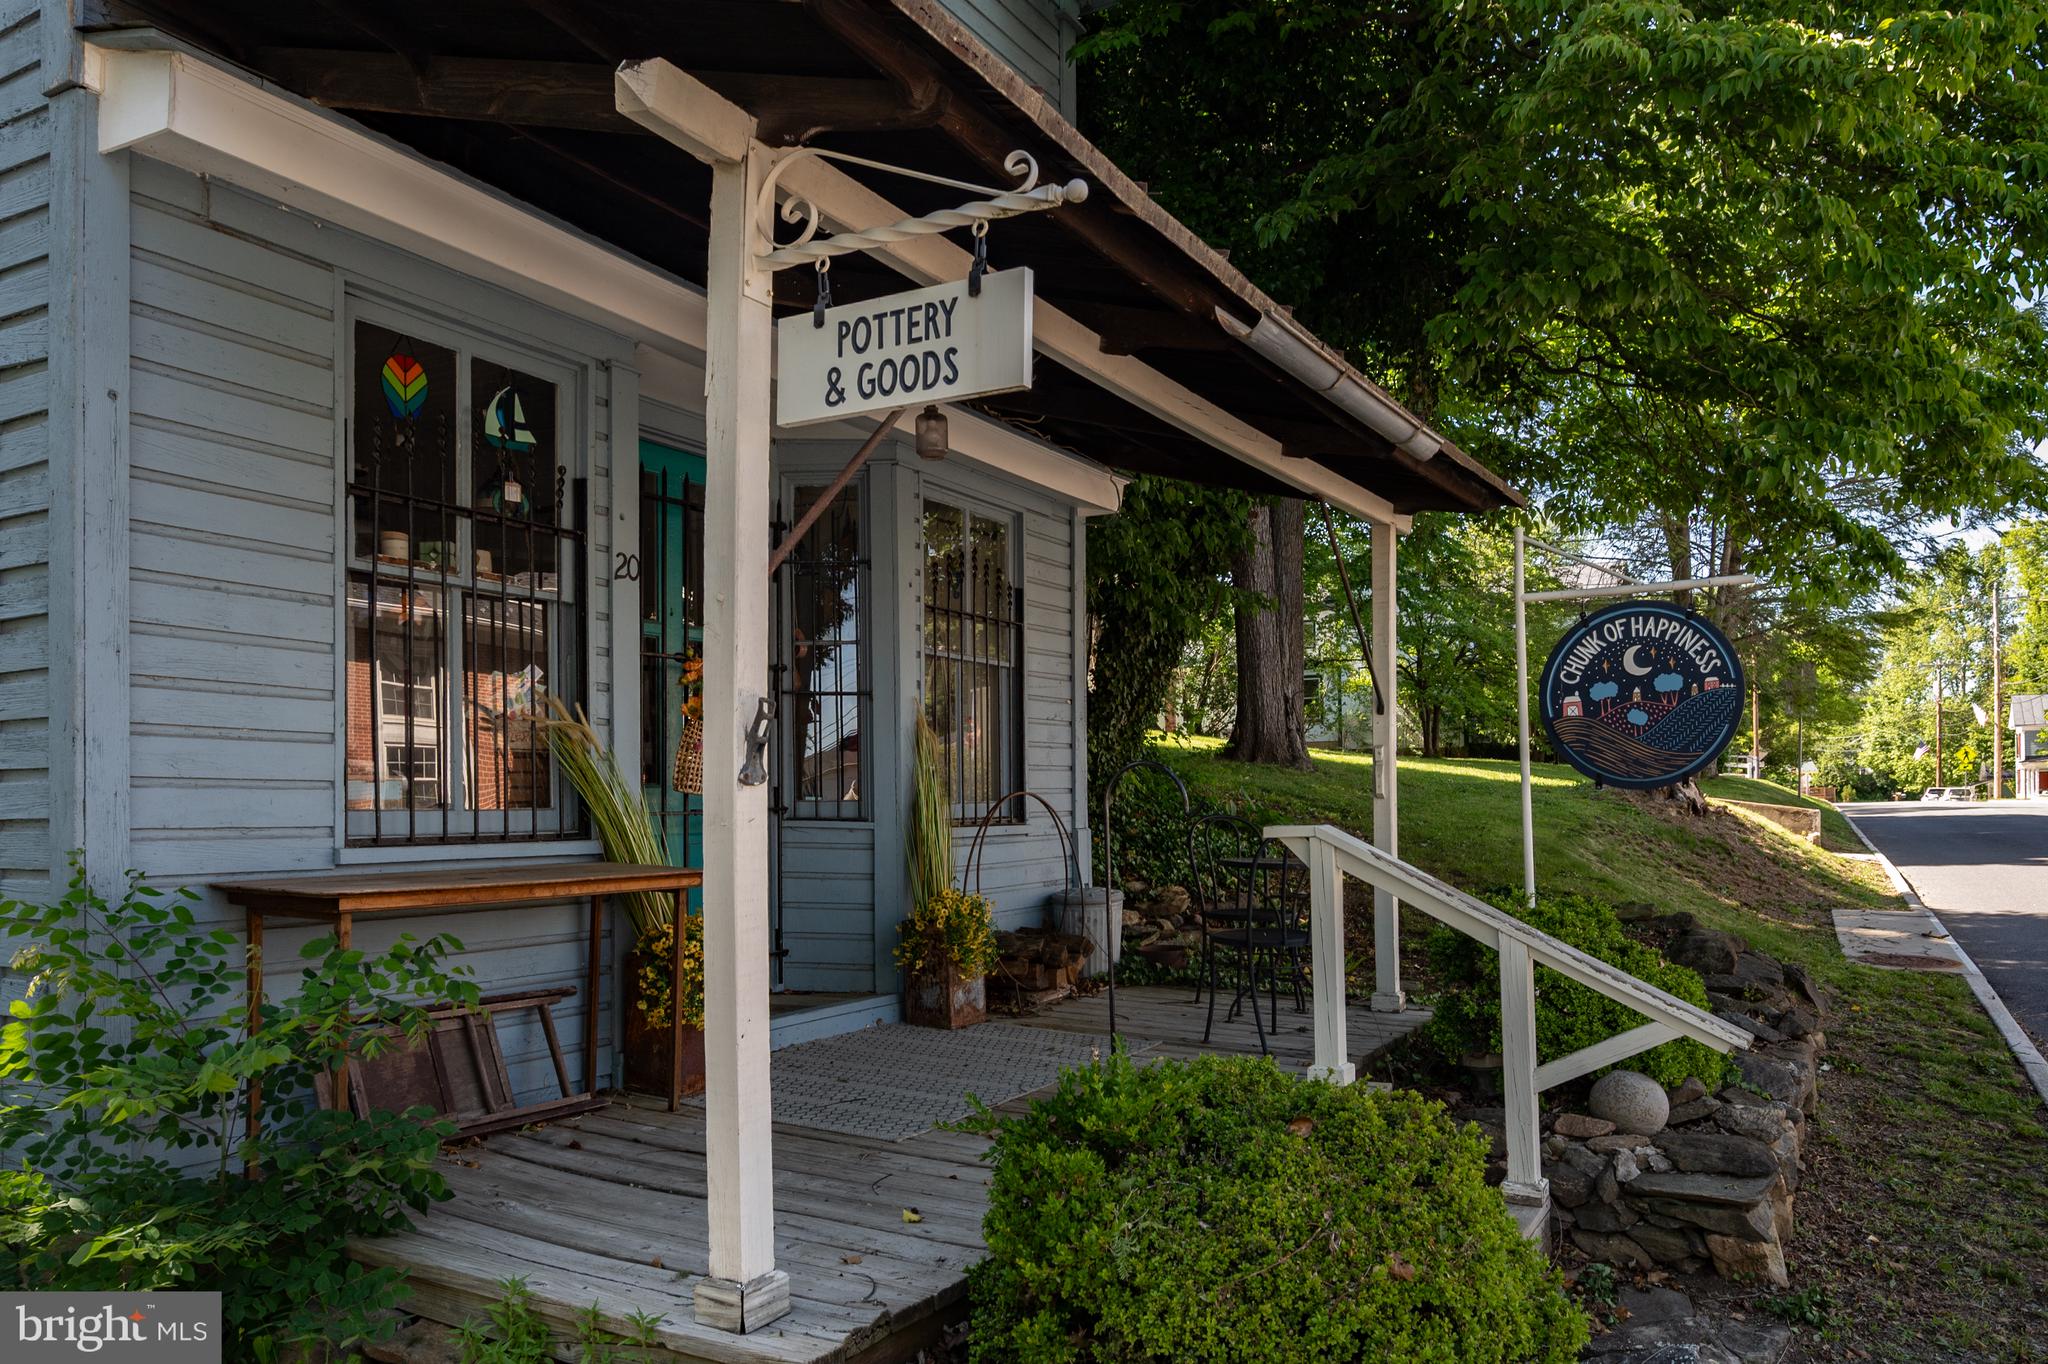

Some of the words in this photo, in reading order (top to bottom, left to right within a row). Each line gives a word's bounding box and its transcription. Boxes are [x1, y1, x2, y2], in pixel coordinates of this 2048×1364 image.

[837, 296, 959, 358] POTTERY
[824, 366, 847, 408] &
[857, 347, 959, 400] GOODS
[614, 552, 640, 581] 20
[1560, 630, 1608, 685] CHUNK
[1604, 618, 1627, 642] OF
[1631, 616, 1722, 674] HAPPINESS
